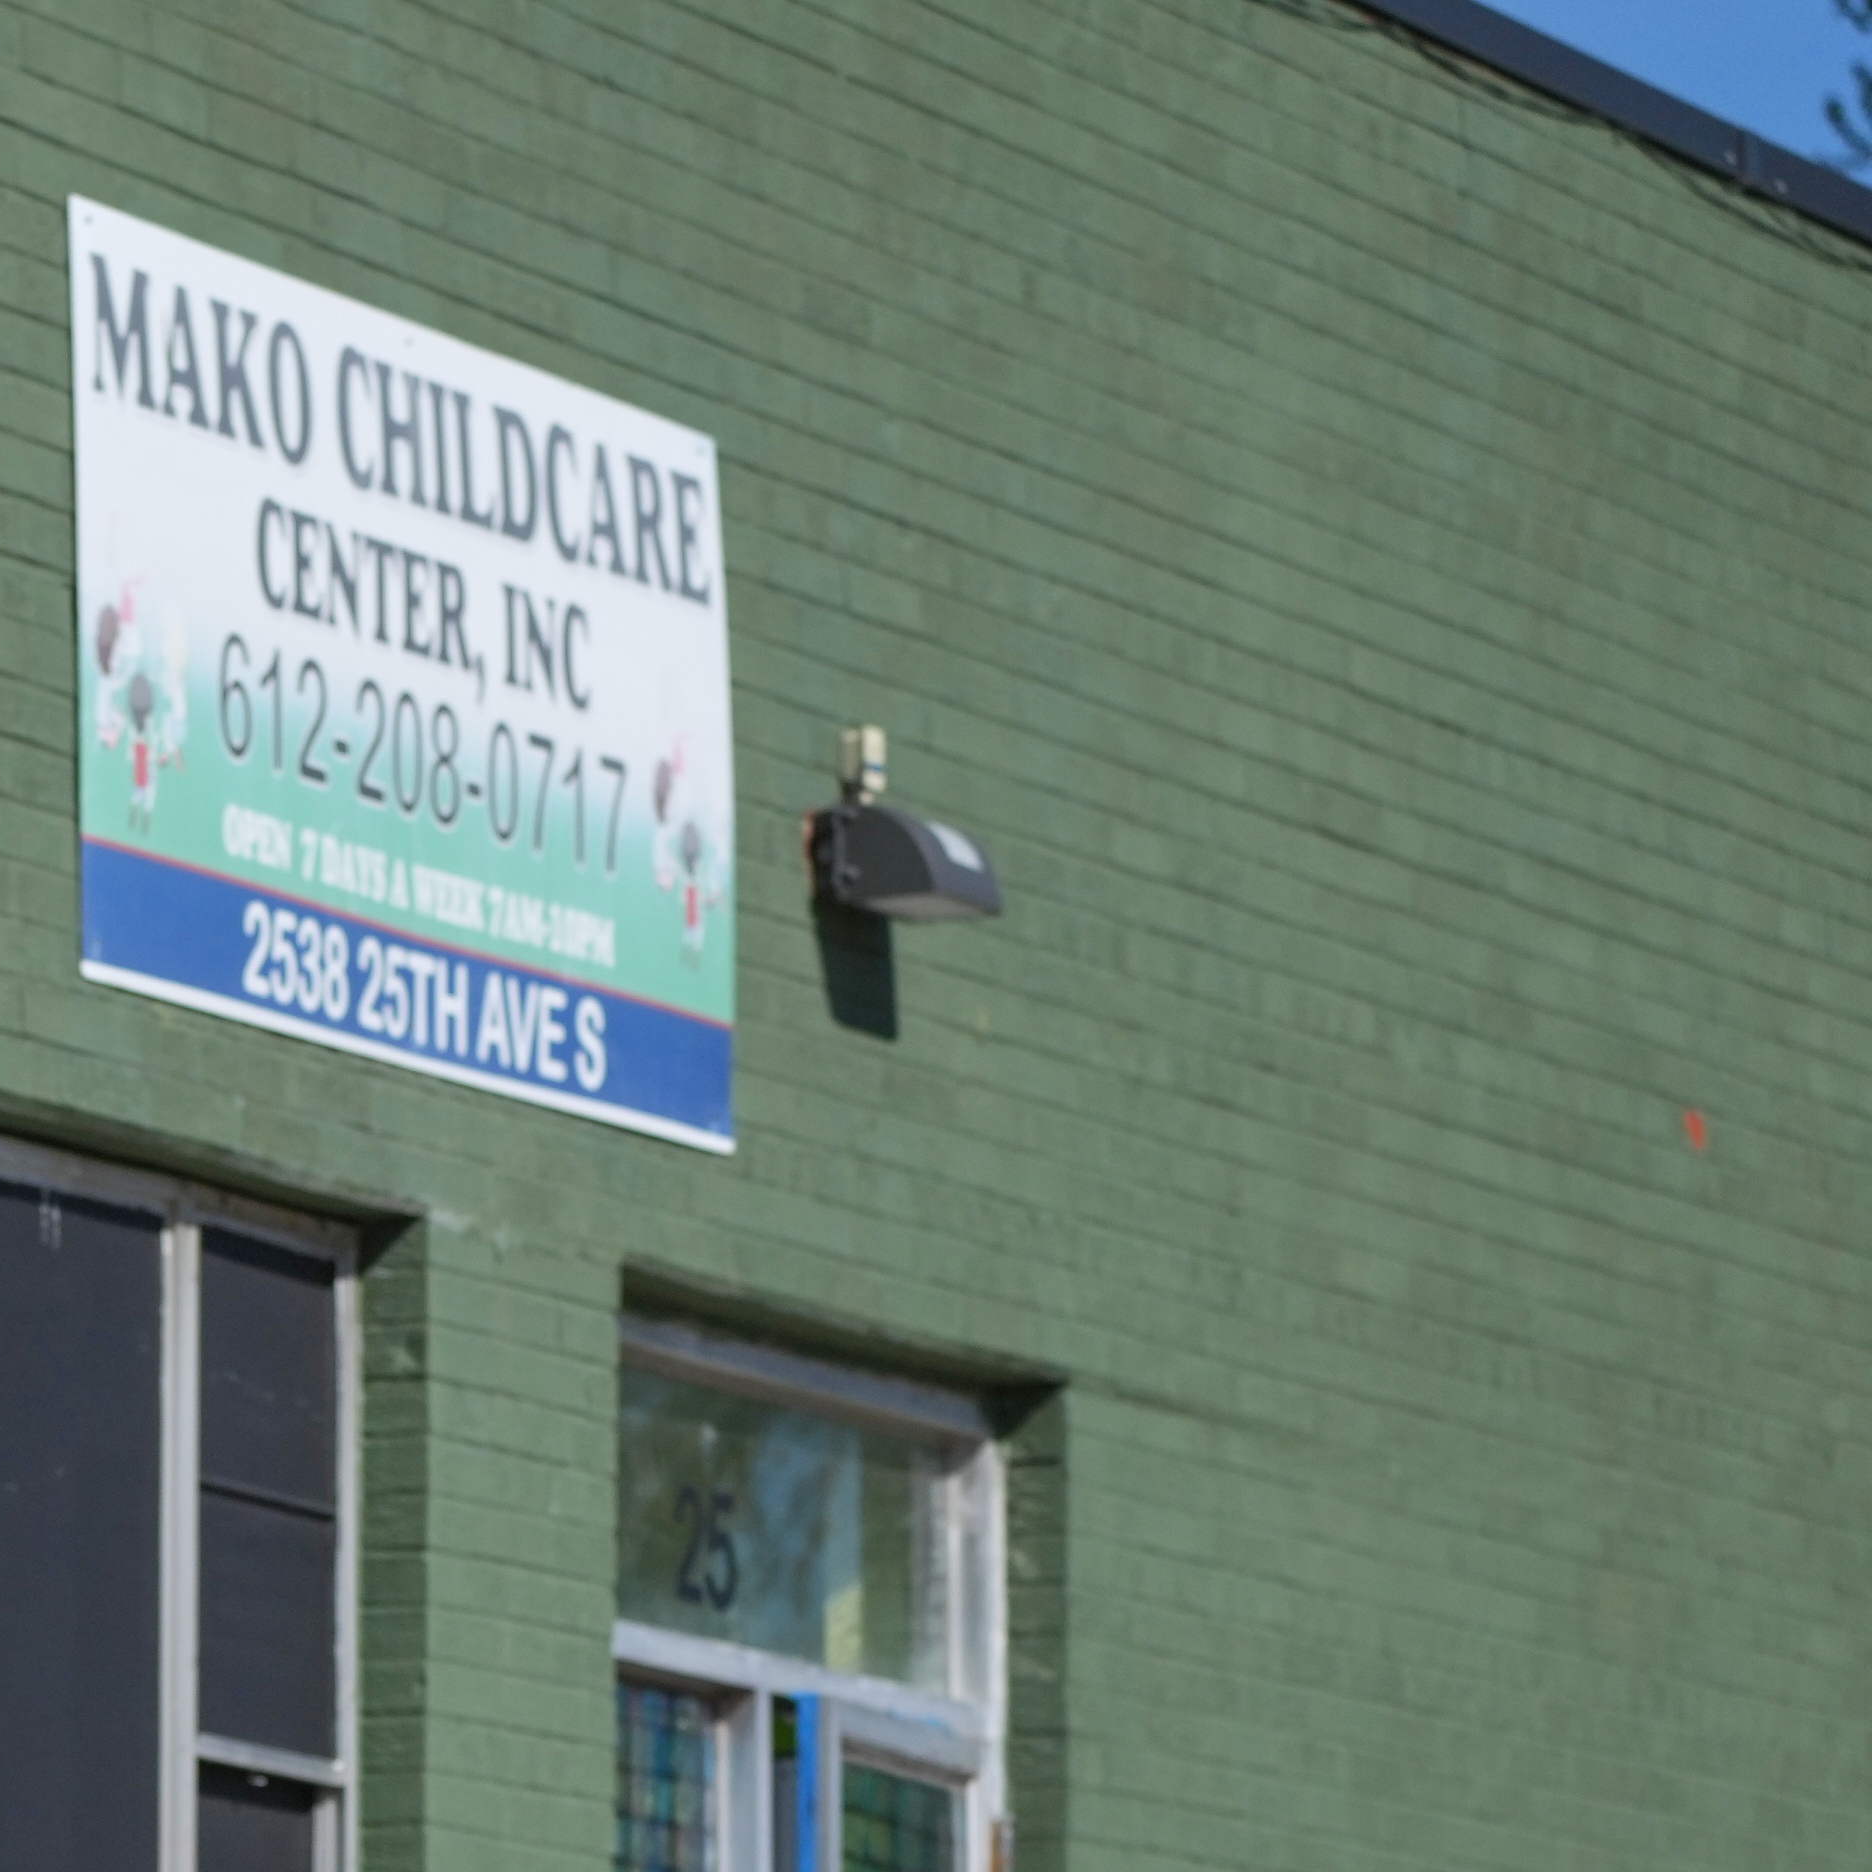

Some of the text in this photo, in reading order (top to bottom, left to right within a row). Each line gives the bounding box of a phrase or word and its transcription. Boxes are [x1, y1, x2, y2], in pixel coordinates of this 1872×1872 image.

[89, 252, 711, 605] MAKO CHILDCARE
[256, 497, 591, 712] CENTER, INC
[218, 633, 628, 874] 612-208-0717
[222, 803, 293, 871] OPEN
[299, 827, 318, 881] 7
[321, 834, 388, 903] DAYS
[388, 859, 409, 911] A
[411, 864, 485, 932] WEEK
[242, 900, 607, 1093] 2538 25TH AVE S
[673, 1487, 738, 1612] 25
